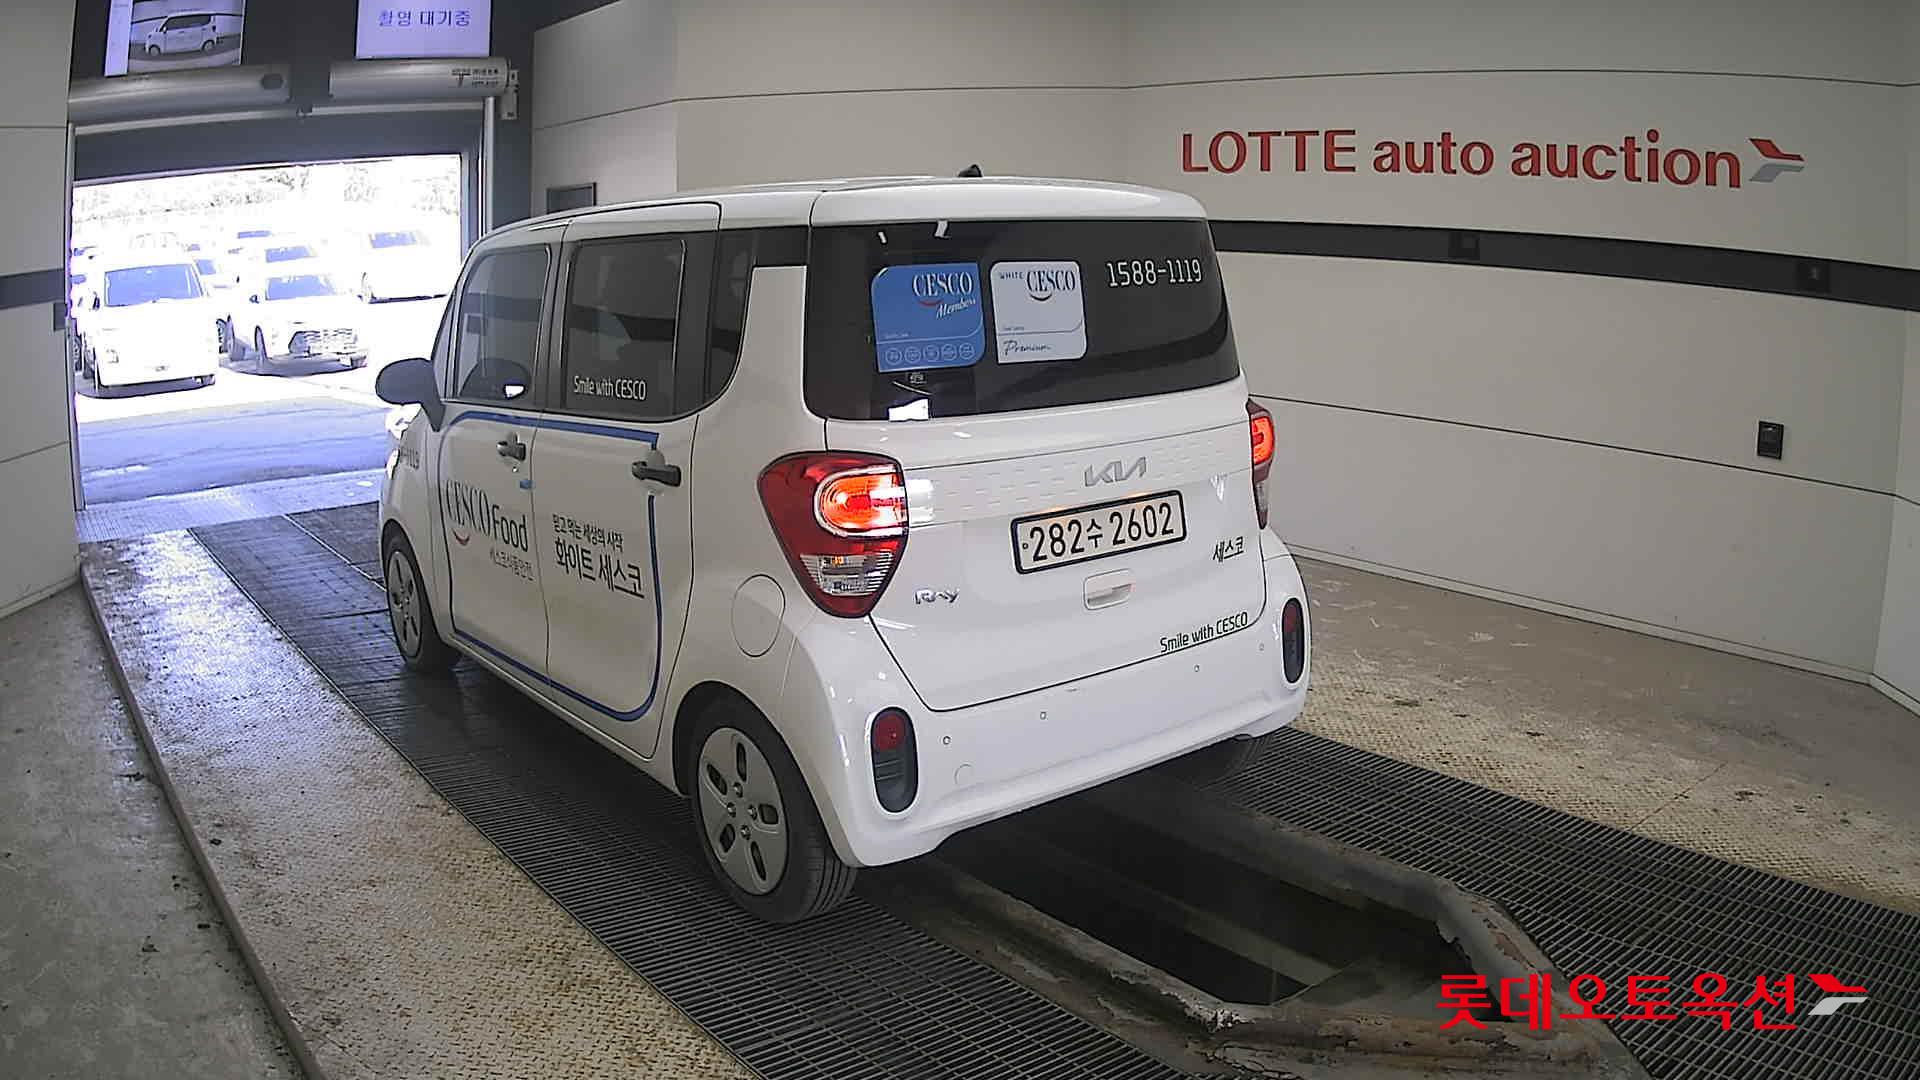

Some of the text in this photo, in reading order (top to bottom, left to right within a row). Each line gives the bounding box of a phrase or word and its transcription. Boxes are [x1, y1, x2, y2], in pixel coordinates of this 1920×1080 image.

[420, 10, 470, 26] 대기중
[1182, 129, 1742, 188] LOTTE auto auction
[912, 271, 973, 297] CESCO
[999, 269, 1076, 292] WHITE CESCO
[1105, 258, 1202, 287] 1588-1119
[574, 375, 646, 400] Smile with CESCO
[446, 479, 529, 553] CESCO Food
[1030, 502, 1175, 562] 282수 2602
[1212, 536, 1244, 563] 세스코
[555, 536, 645, 599] 화이트 세스코
[1160, 611, 1248, 653] Smile with CESCO
